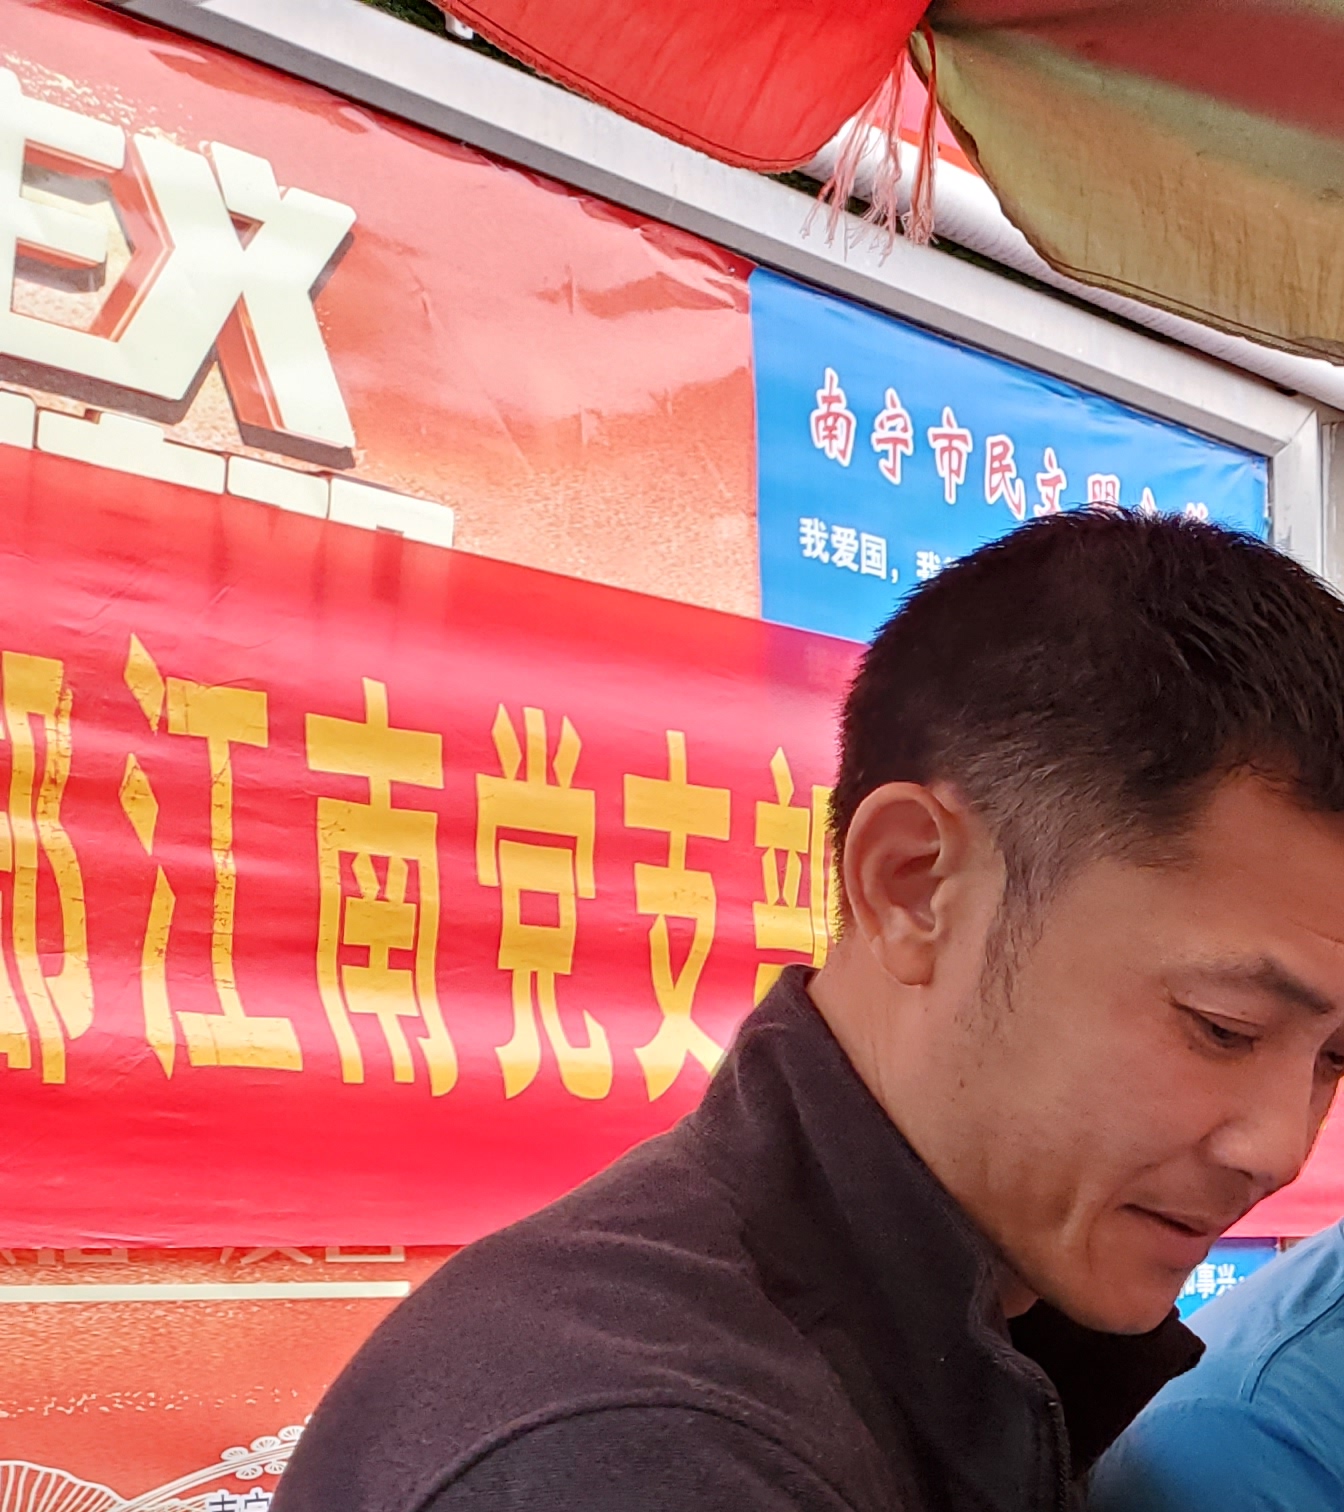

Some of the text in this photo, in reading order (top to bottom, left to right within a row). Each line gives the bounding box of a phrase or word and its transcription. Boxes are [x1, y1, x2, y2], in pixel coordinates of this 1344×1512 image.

[810, 368, 1208, 521] 南宁市民文明
